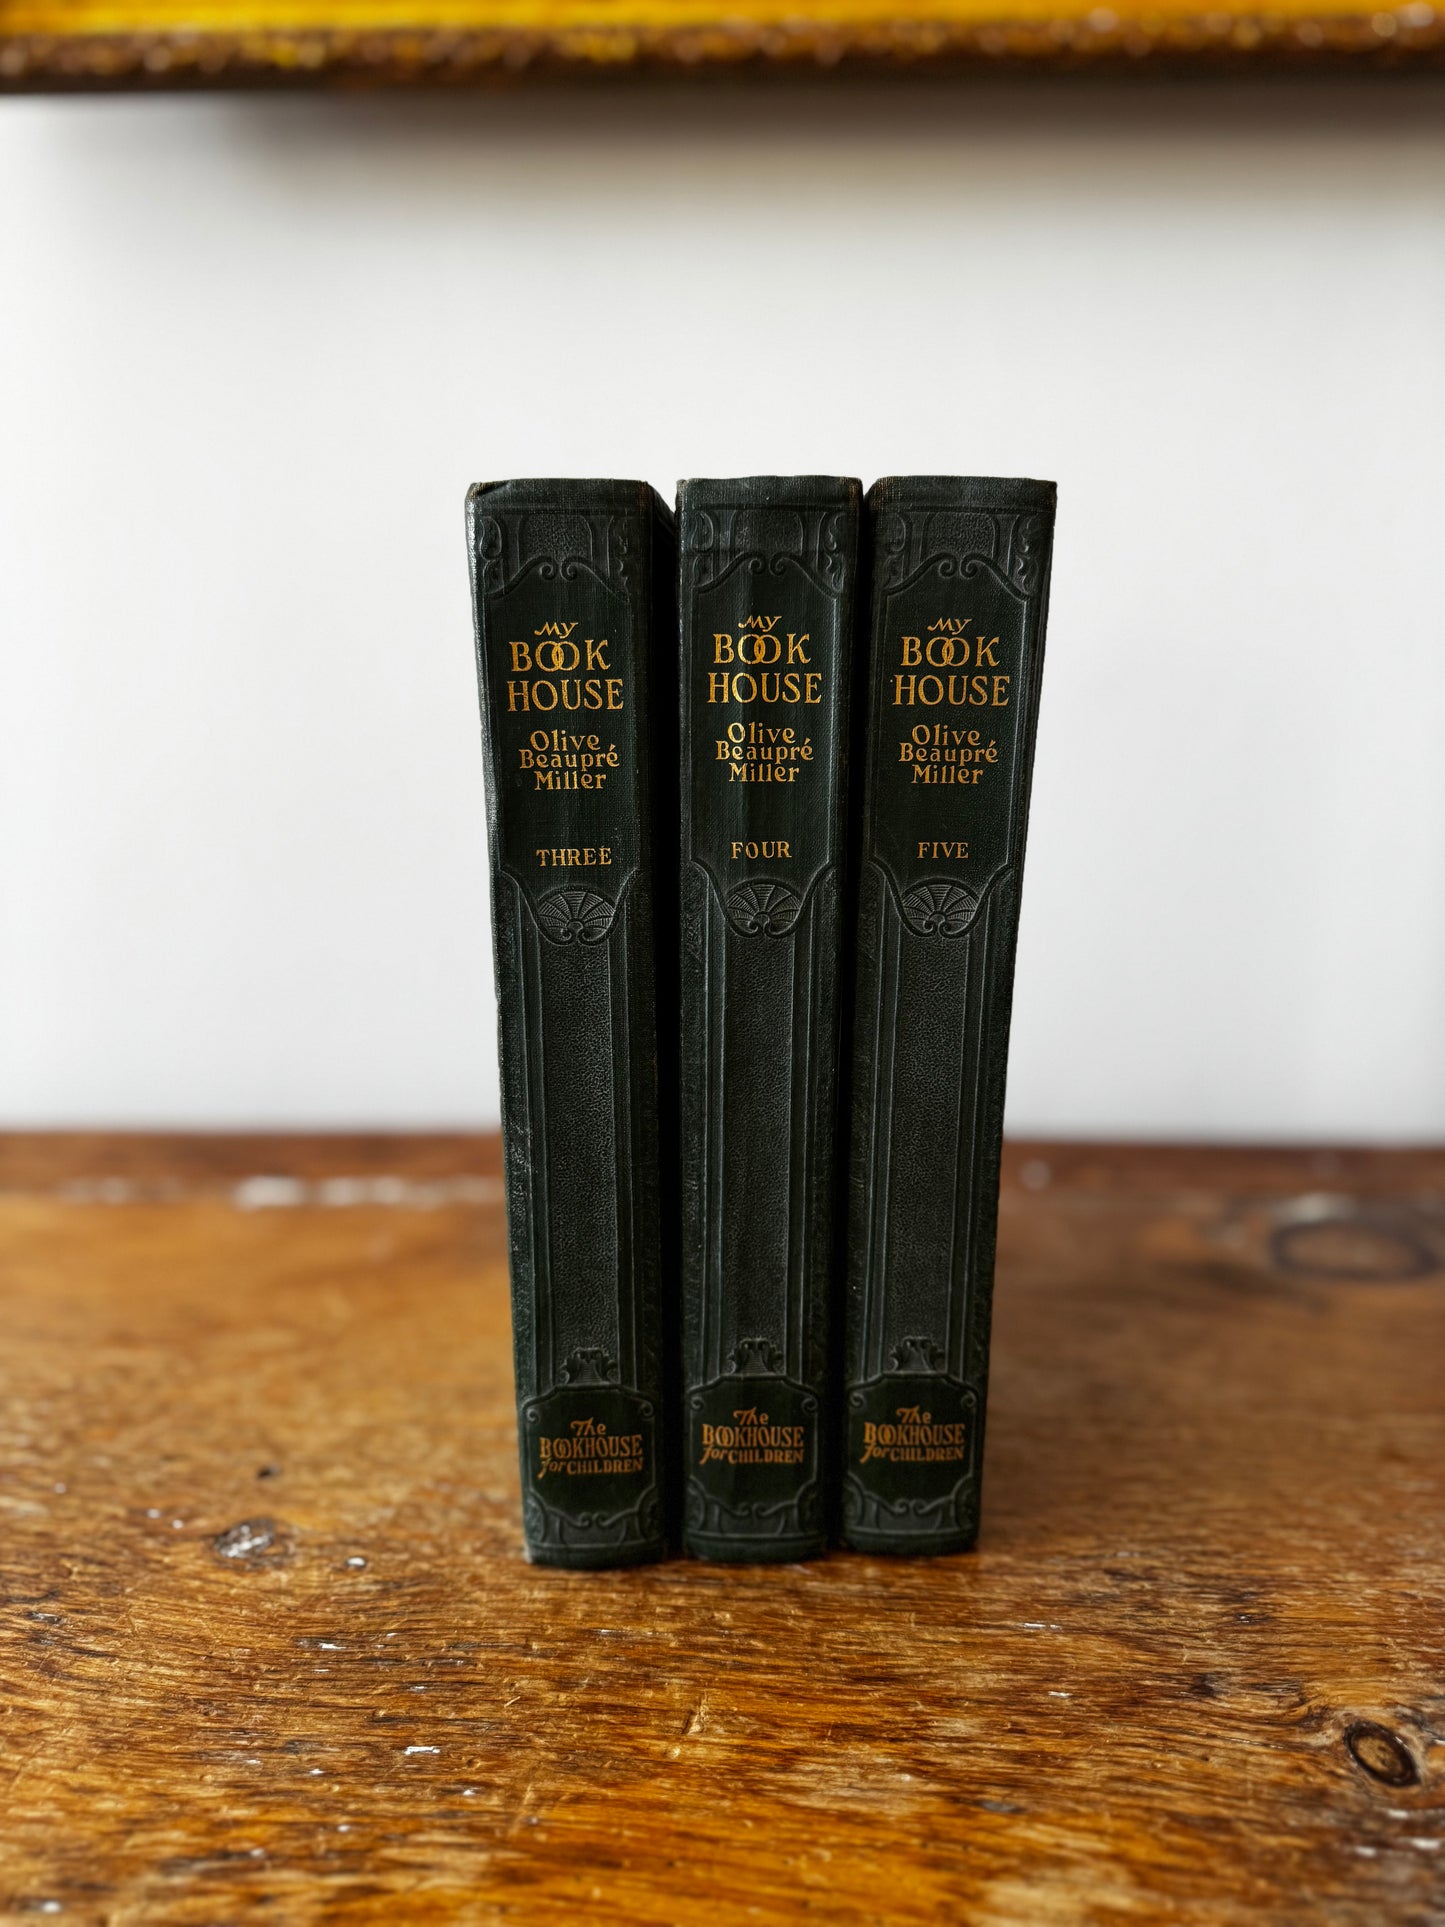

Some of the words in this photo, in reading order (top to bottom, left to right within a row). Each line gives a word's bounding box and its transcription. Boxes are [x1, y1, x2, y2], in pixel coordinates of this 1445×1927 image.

[508, 639, 612, 673] BOOK
[713, 633, 812, 665] BOOK
[900, 636, 1001, 668] BOOK
[506, 678, 624, 712] HOUSE
[707, 672, 822, 704] HOUSE
[892, 674, 1010, 707] HOUSE
[530, 729, 601, 752] Olive
[727, 721, 796, 744] Olive
[911, 723, 981, 746] Olive
[518, 743, 620, 771] Beaupré
[715, 737, 814, 764] Beaupré
[898, 740, 999, 767] Beaupré
[533, 770, 607, 790] Miller
[728, 762, 800, 782] Miller
[911, 764, 984, 784] Miller
[535, 847, 612, 867] THREE
[731, 841, 792, 859] FOUR
[916, 841, 969, 859] FIVE
[570, 1416, 607, 1436] The
[733, 1406, 769, 1425] The
[896, 1405, 932, 1424] The
[702, 1423, 804, 1447] BOOKHOUSE
[863, 1421, 965, 1446] BOOKHOUSE
[539, 1433, 643, 1459] BOOKHOUSE
[699, 1444, 728, 1465] for
[727, 1449, 804, 1465] CHILDREN
[860, 1443, 890, 1463] for
[889, 1446, 965, 1462] CHILDREN
[537, 1457, 566, 1479] for
[566, 1457, 643, 1475] CHILDREN
